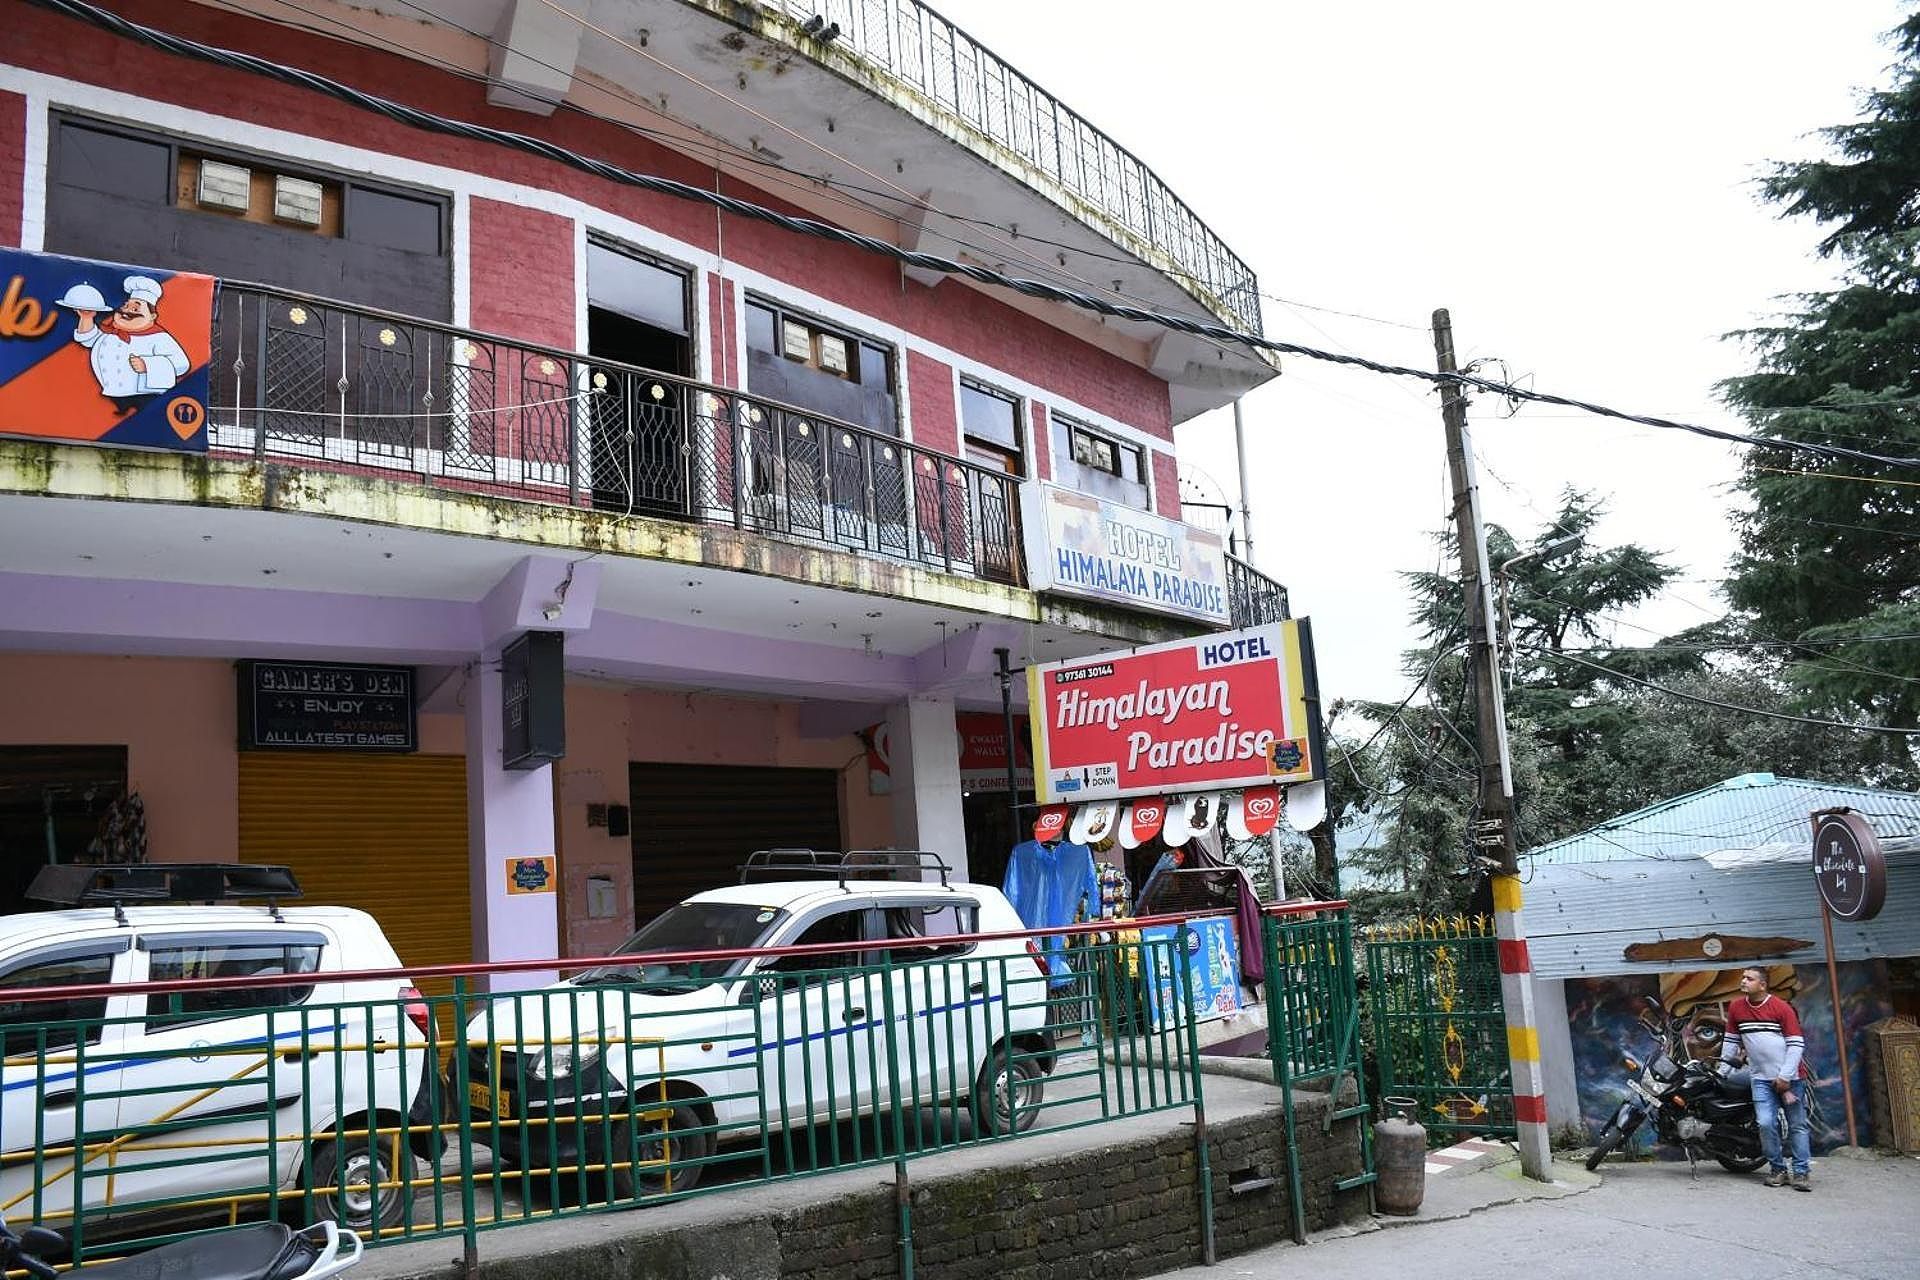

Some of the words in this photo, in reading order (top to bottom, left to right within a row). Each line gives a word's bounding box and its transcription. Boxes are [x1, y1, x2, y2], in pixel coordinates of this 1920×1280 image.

[1105, 519, 1182, 572] HOTEL
[1056, 547, 1149, 598] HIMALAYA
[1152, 570, 1223, 614] PARADISE
[1203, 636, 1271, 666] HOTEL
[261, 669, 354, 692] GAMER'S
[365, 673, 405, 694] DEN
[1064, 669, 1086, 681] 97361
[1088, 665, 1113, 678] 30144
[303, 699, 364, 713] ENJOY
[1056, 679, 1232, 731] Himalayan
[265, 731, 293, 743] ALL
[295, 732, 354, 743] LATEST
[356, 733, 405, 745] GAMES
[1127, 722, 1276, 772] Paradise
[1092, 776, 1116, 787] DOWN
[1095, 766, 1112, 776] STEP
